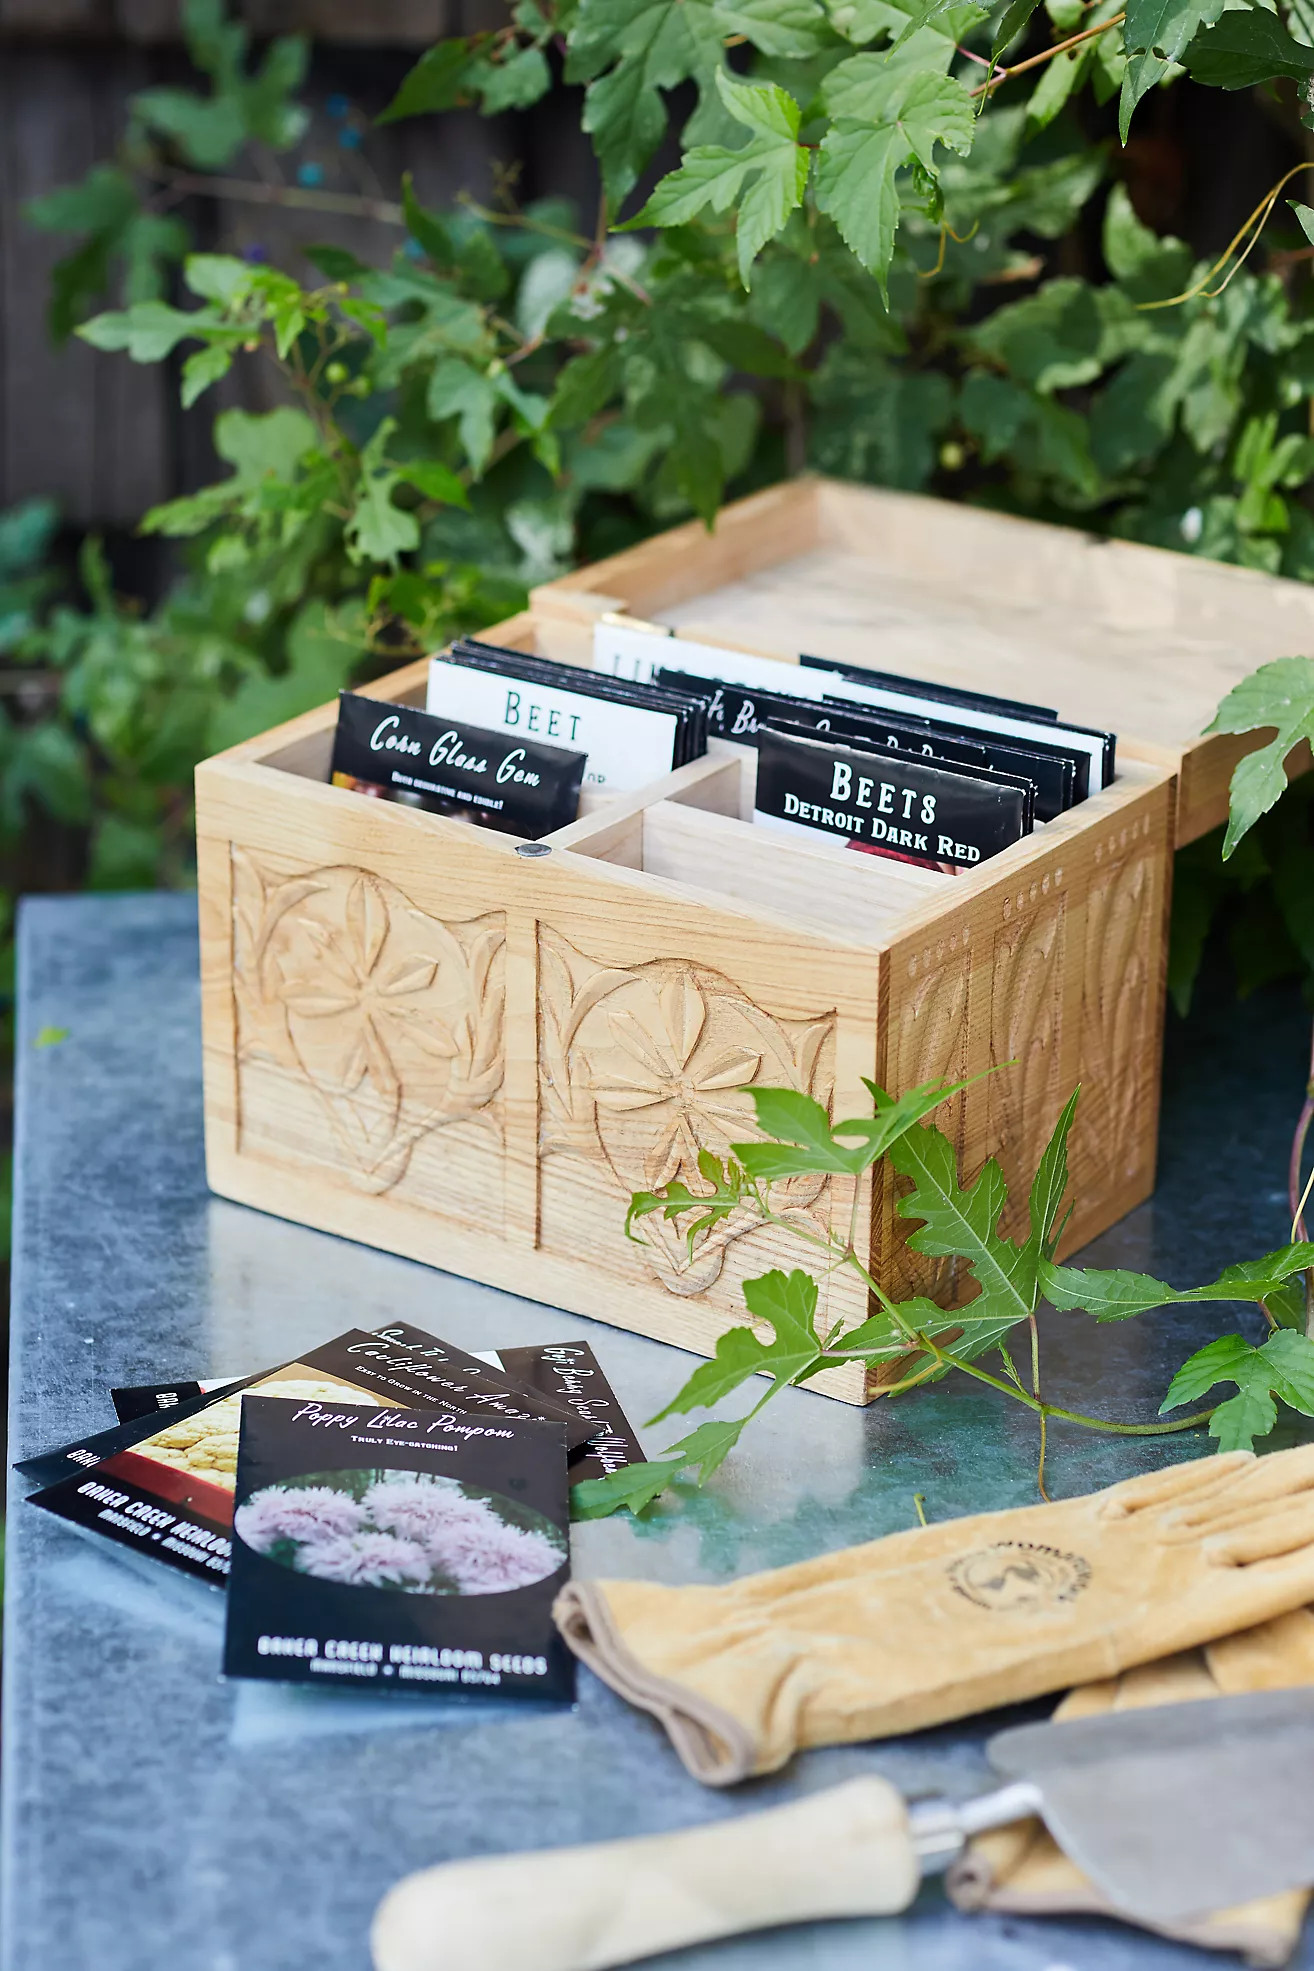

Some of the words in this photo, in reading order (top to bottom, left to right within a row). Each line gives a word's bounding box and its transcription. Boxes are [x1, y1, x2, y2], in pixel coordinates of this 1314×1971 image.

[504, 690, 581, 741] BEET
[370, 715, 421, 755] Corn
[429, 730, 487, 773] Glass
[495, 748, 541, 787] Gem
[829, 761, 937, 825] BEETS
[783, 792, 865, 834] DETROIT
[870, 817, 929, 852] DARK
[936, 834, 981, 863] RED
[347, 1342, 469, 1393] Cauliflower
[291, 1402, 359, 1429] Poppy
[366, 1408, 419, 1430] Lilac
[426, 1413, 515, 1441] Pompom
[77, 1480, 130, 1509] BAKER
[124, 1501, 177, 1529] CREEK
[258, 1635, 318, 1658] BAKER
[489, 1653, 547, 1676] SEEDS
